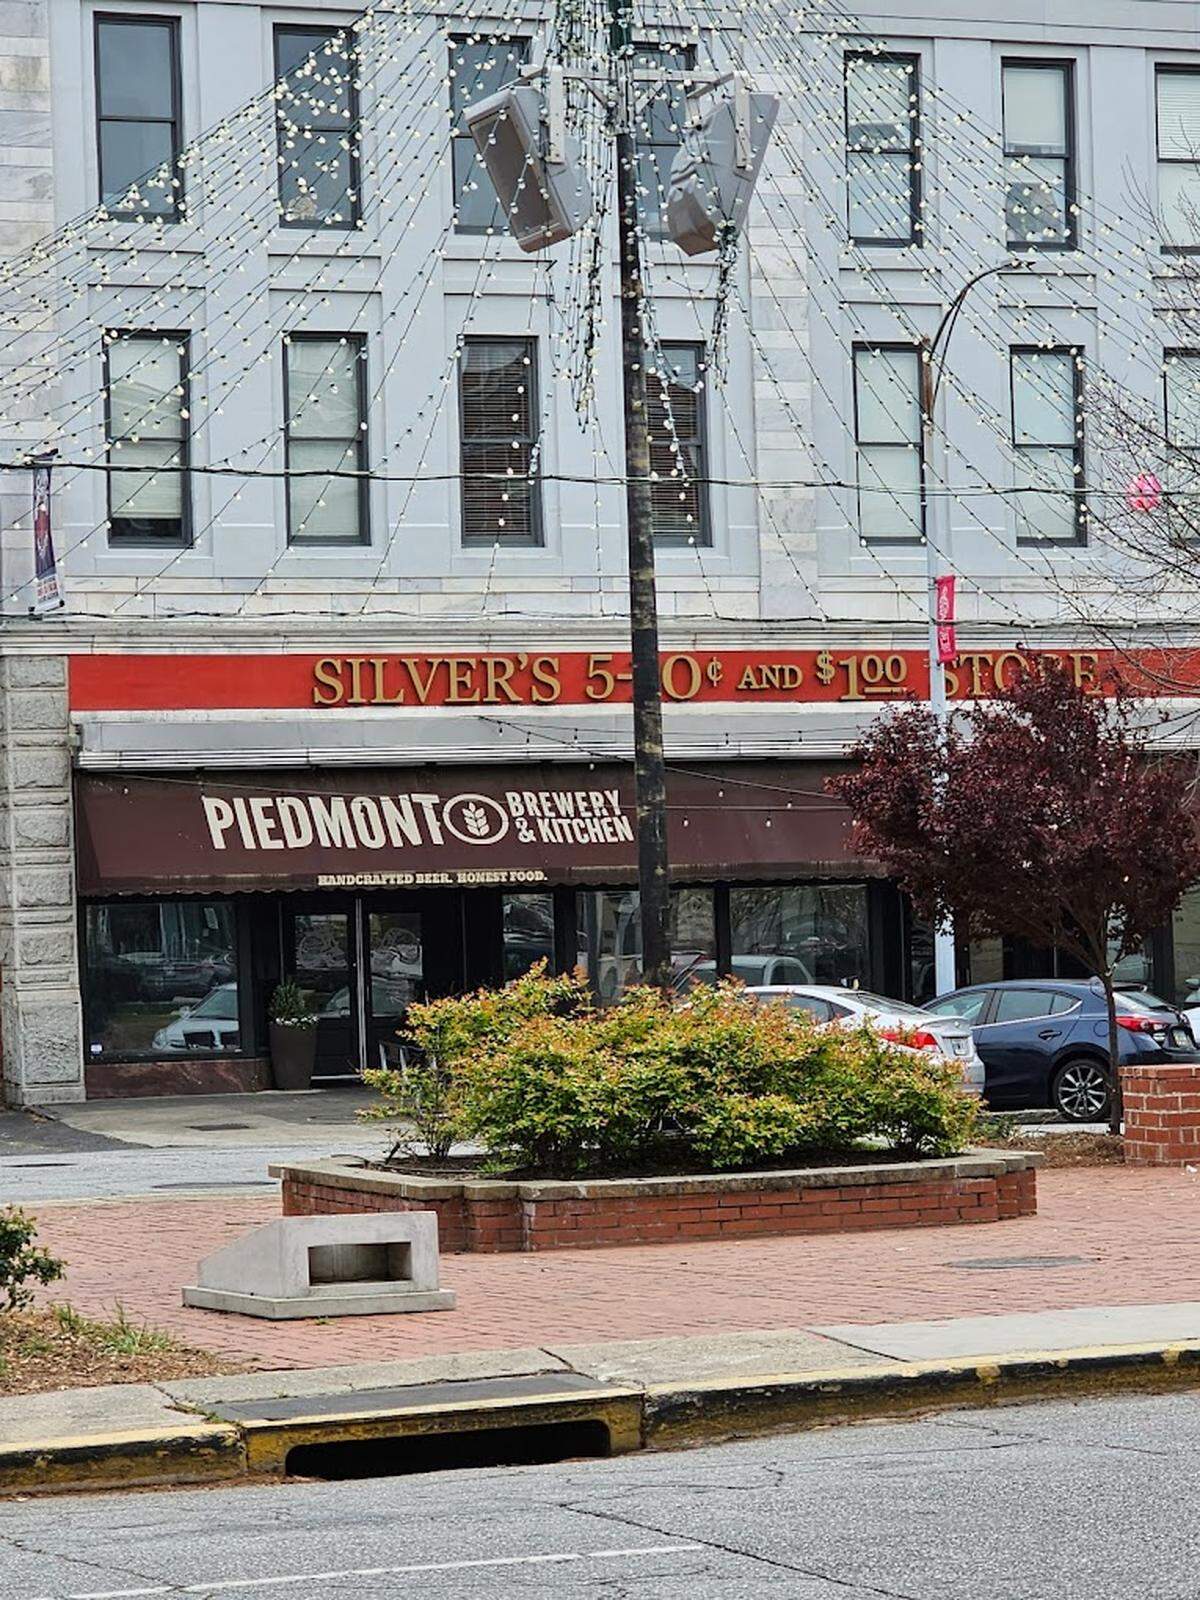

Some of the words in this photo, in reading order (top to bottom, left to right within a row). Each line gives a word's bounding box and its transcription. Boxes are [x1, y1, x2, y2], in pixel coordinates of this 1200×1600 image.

[313, 653, 561, 704] SILVER'S
[736, 664, 803, 689] AND
[505, 790, 621, 818] BREWERY
[201, 793, 444, 850] PIEDMONT
[515, 817, 536, 843] &
[536, 816, 635, 843] KITCHEN
[318, 873, 414, 886] HANDCRAFTED
[415, 873, 453, 884] BEER.
[457, 871, 507, 883] HONEST
[509, 870, 548, 882] FOOD.
